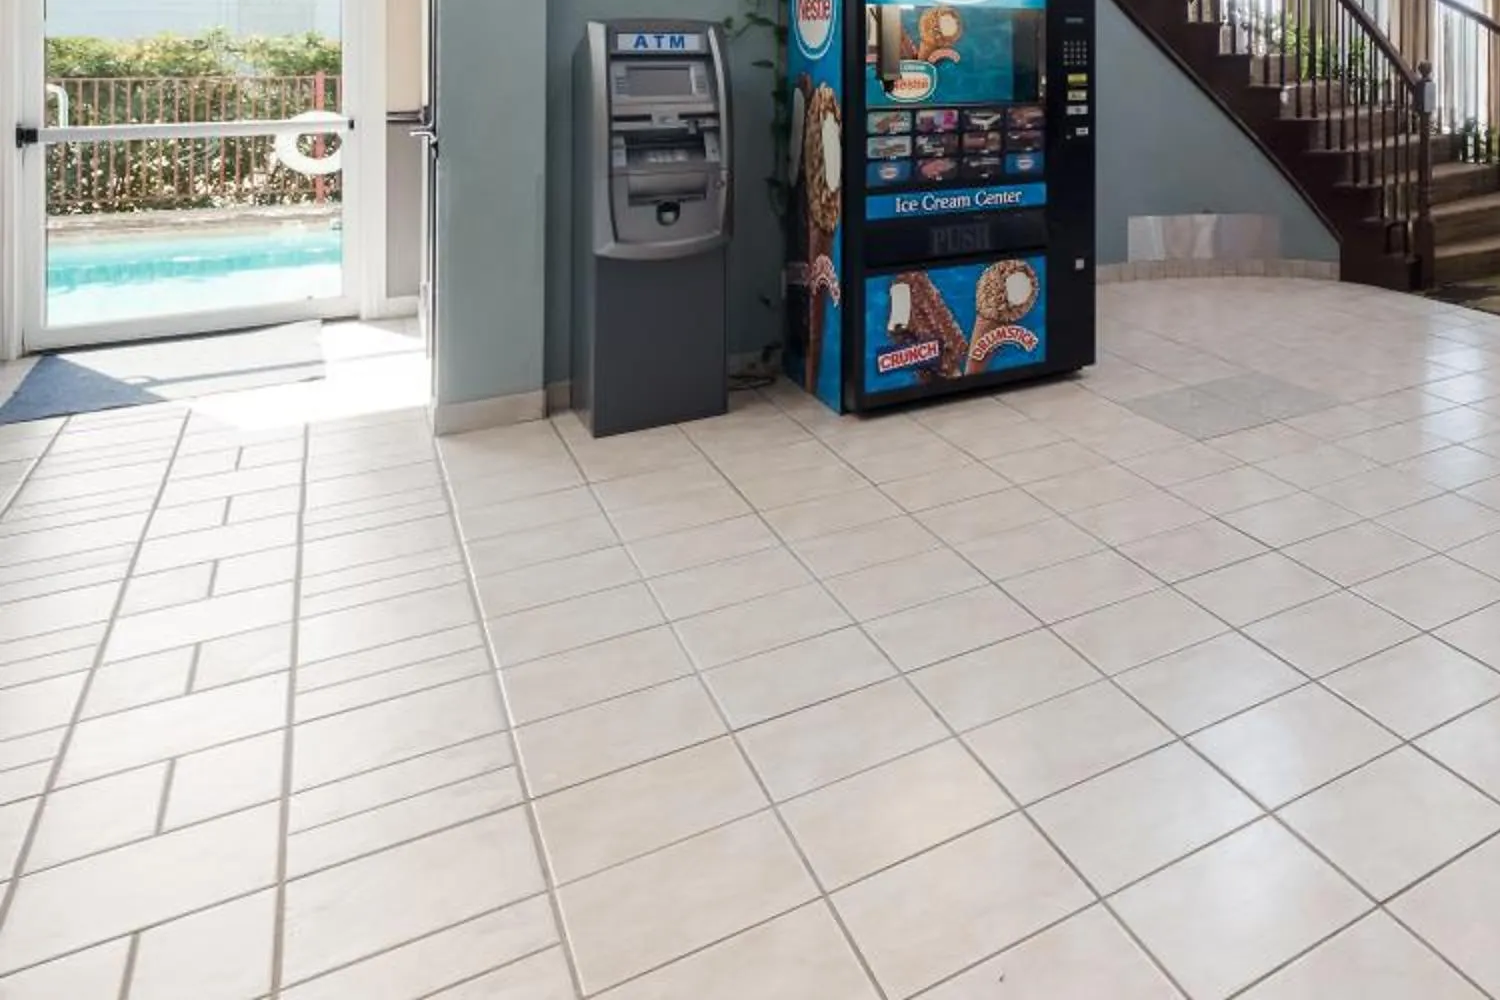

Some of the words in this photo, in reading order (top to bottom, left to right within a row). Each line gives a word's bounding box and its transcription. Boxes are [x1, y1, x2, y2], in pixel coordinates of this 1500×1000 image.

[634, 35, 685, 49] ATM
[895, 197, 918, 213] Ice
[922, 193, 971, 211] Cream
[975, 190, 1022, 206] Center
[930, 223, 990, 255] PUSH
[879, 342, 939, 371] CRUNCH
[972, 324, 1038, 361] DRUMSTICK
